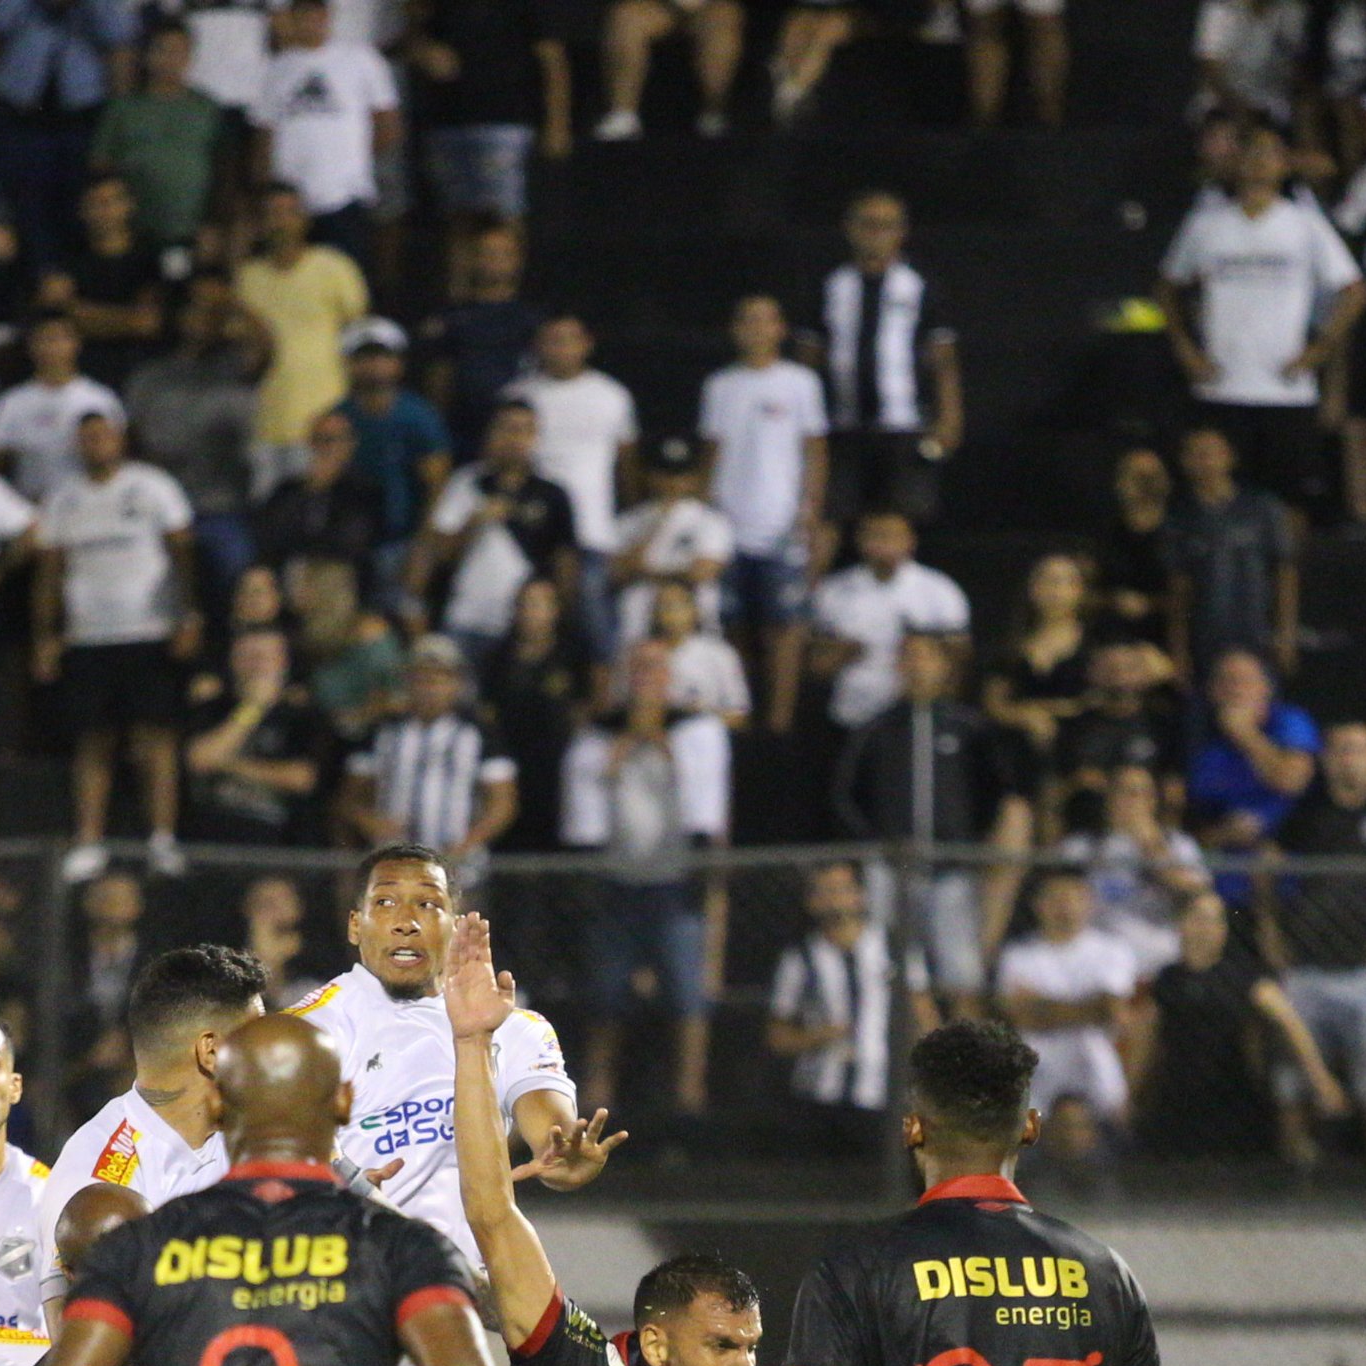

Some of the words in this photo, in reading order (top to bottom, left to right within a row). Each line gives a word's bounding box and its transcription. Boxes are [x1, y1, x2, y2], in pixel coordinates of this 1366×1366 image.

[154, 1233, 349, 1286] DISLUB
[231, 1281, 347, 1311] energia
[913, 1256, 1089, 1302] DISLUB
[995, 1303, 1092, 1330] energia
